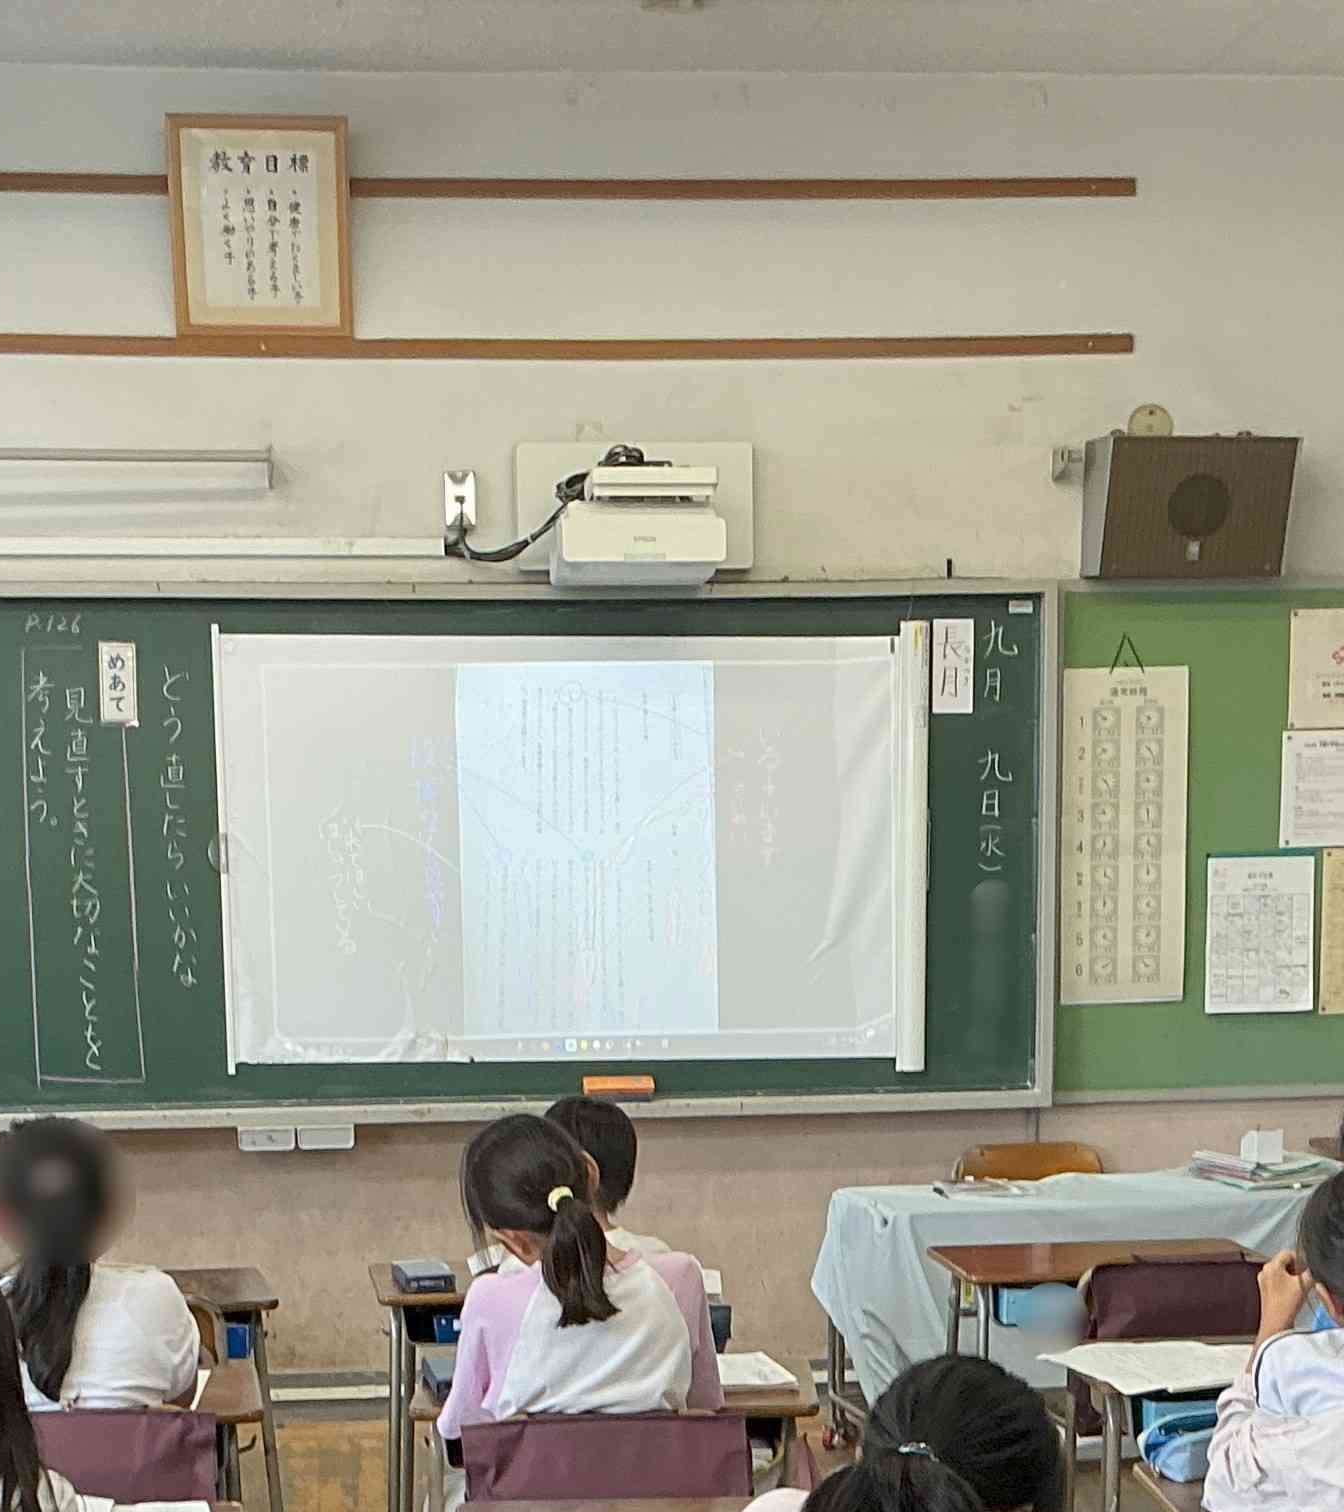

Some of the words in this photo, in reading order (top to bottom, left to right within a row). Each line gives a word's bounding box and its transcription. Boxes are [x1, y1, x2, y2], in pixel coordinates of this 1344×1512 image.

[209, 150, 309, 175] 教育目標
[107, 653, 126, 713] めあて
[937, 625, 963, 699] 長月
[984, 619, 1019, 703] 九月
